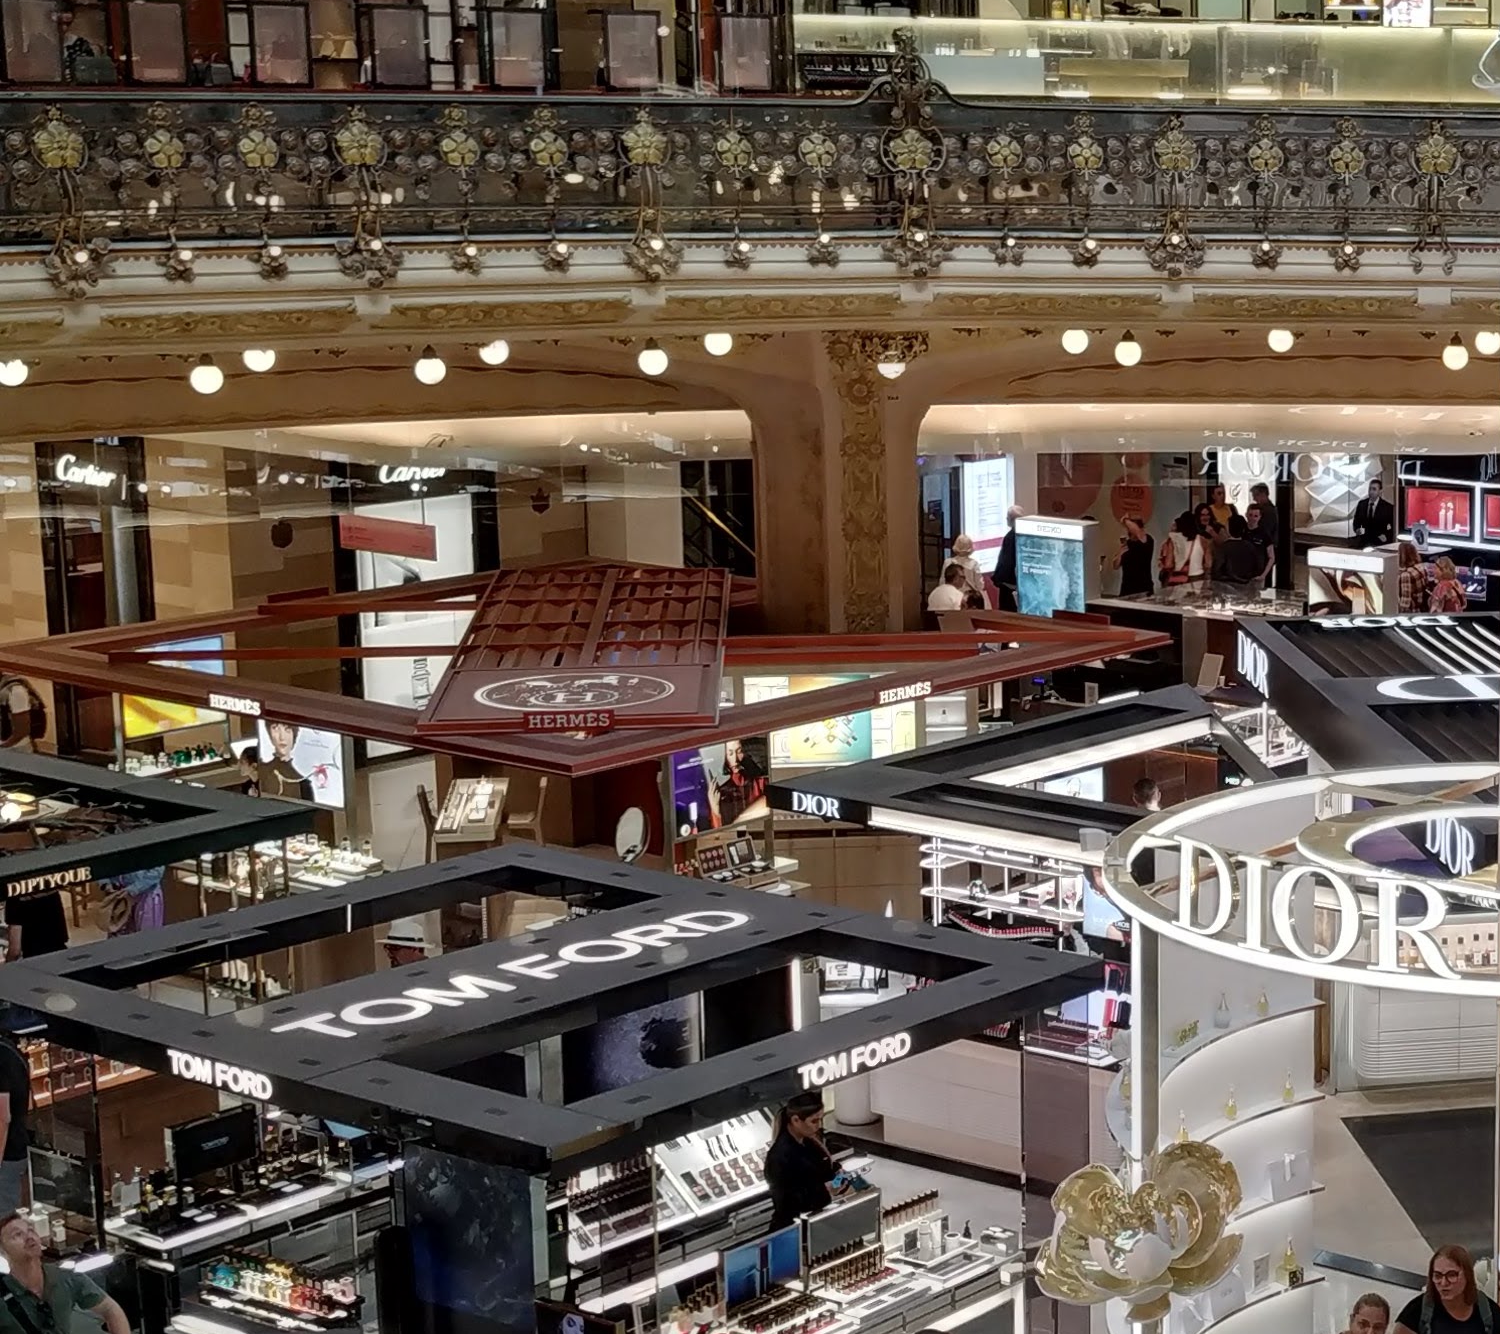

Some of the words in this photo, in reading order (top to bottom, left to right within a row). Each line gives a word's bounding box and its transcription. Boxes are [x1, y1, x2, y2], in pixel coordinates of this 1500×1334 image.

[56, 454, 116, 488] Cartier
[1237, 630, 1269, 699] DIOR
[791, 791, 840, 819] DIOR
[1425, 815, 1475, 875] DIOR
[1172, 835, 1461, 979] DIOR
[272, 974, 516, 1039] TOM
[499, 908, 754, 981] FORD
[167, 1049, 213, 1081] TOM
[215, 1062, 273, 1101] FORD
[798, 1051, 848, 1089] TOM
[851, 1033, 911, 1074] FORD
